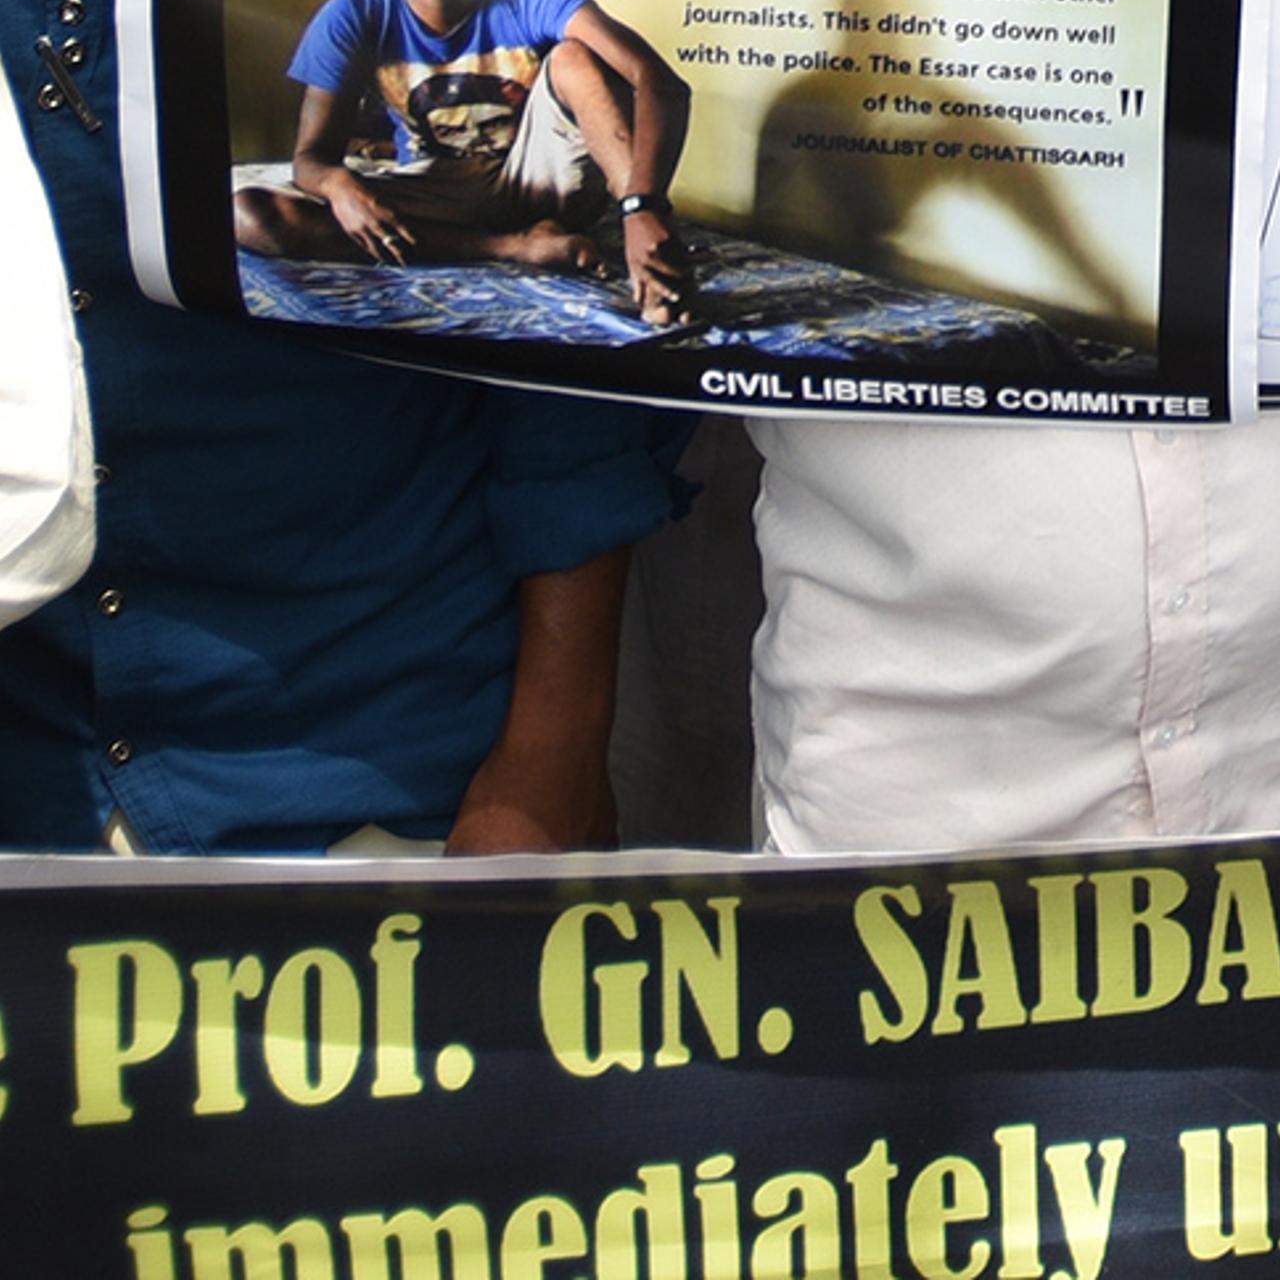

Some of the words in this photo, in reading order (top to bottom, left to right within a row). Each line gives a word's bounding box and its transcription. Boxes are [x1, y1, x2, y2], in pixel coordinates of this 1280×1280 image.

[683, 2, 815, 29] journalists.
[823, 10, 870, 33] This
[877, 13, 947, 36] didn't
[954, 22, 985, 43] go
[991, 20, 1059, 42] down
[1066, 25, 1116, 45] well
[677, 43, 730, 65] with
[737, 47, 776, 68] the
[783, 51, 861, 73] police.
[868, 53, 912, 75] The
[919, 57, 980, 78] Essar
[986, 63, 1038, 81] case
[1044, 62, 1063, 83] is
[1070, 69, 1115, 87] one
[862, 94, 888, 113] of
[894, 95, 932, 115] the
[939, 97, 1113, 126] consequences.
[791, 133, 928, 158] JOURNALIST
[933, 141, 962, 160] OF
[969, 144, 1126, 168] CHATTISGARH
[700, 369, 793, 400] CIVIL
[801, 375, 987, 409] LIBERTIES
[996, 386, 1210, 418] COMMITTEE
[68, 911, 476, 1127] Prof.
[538, 894, 795, 1077] GN.
